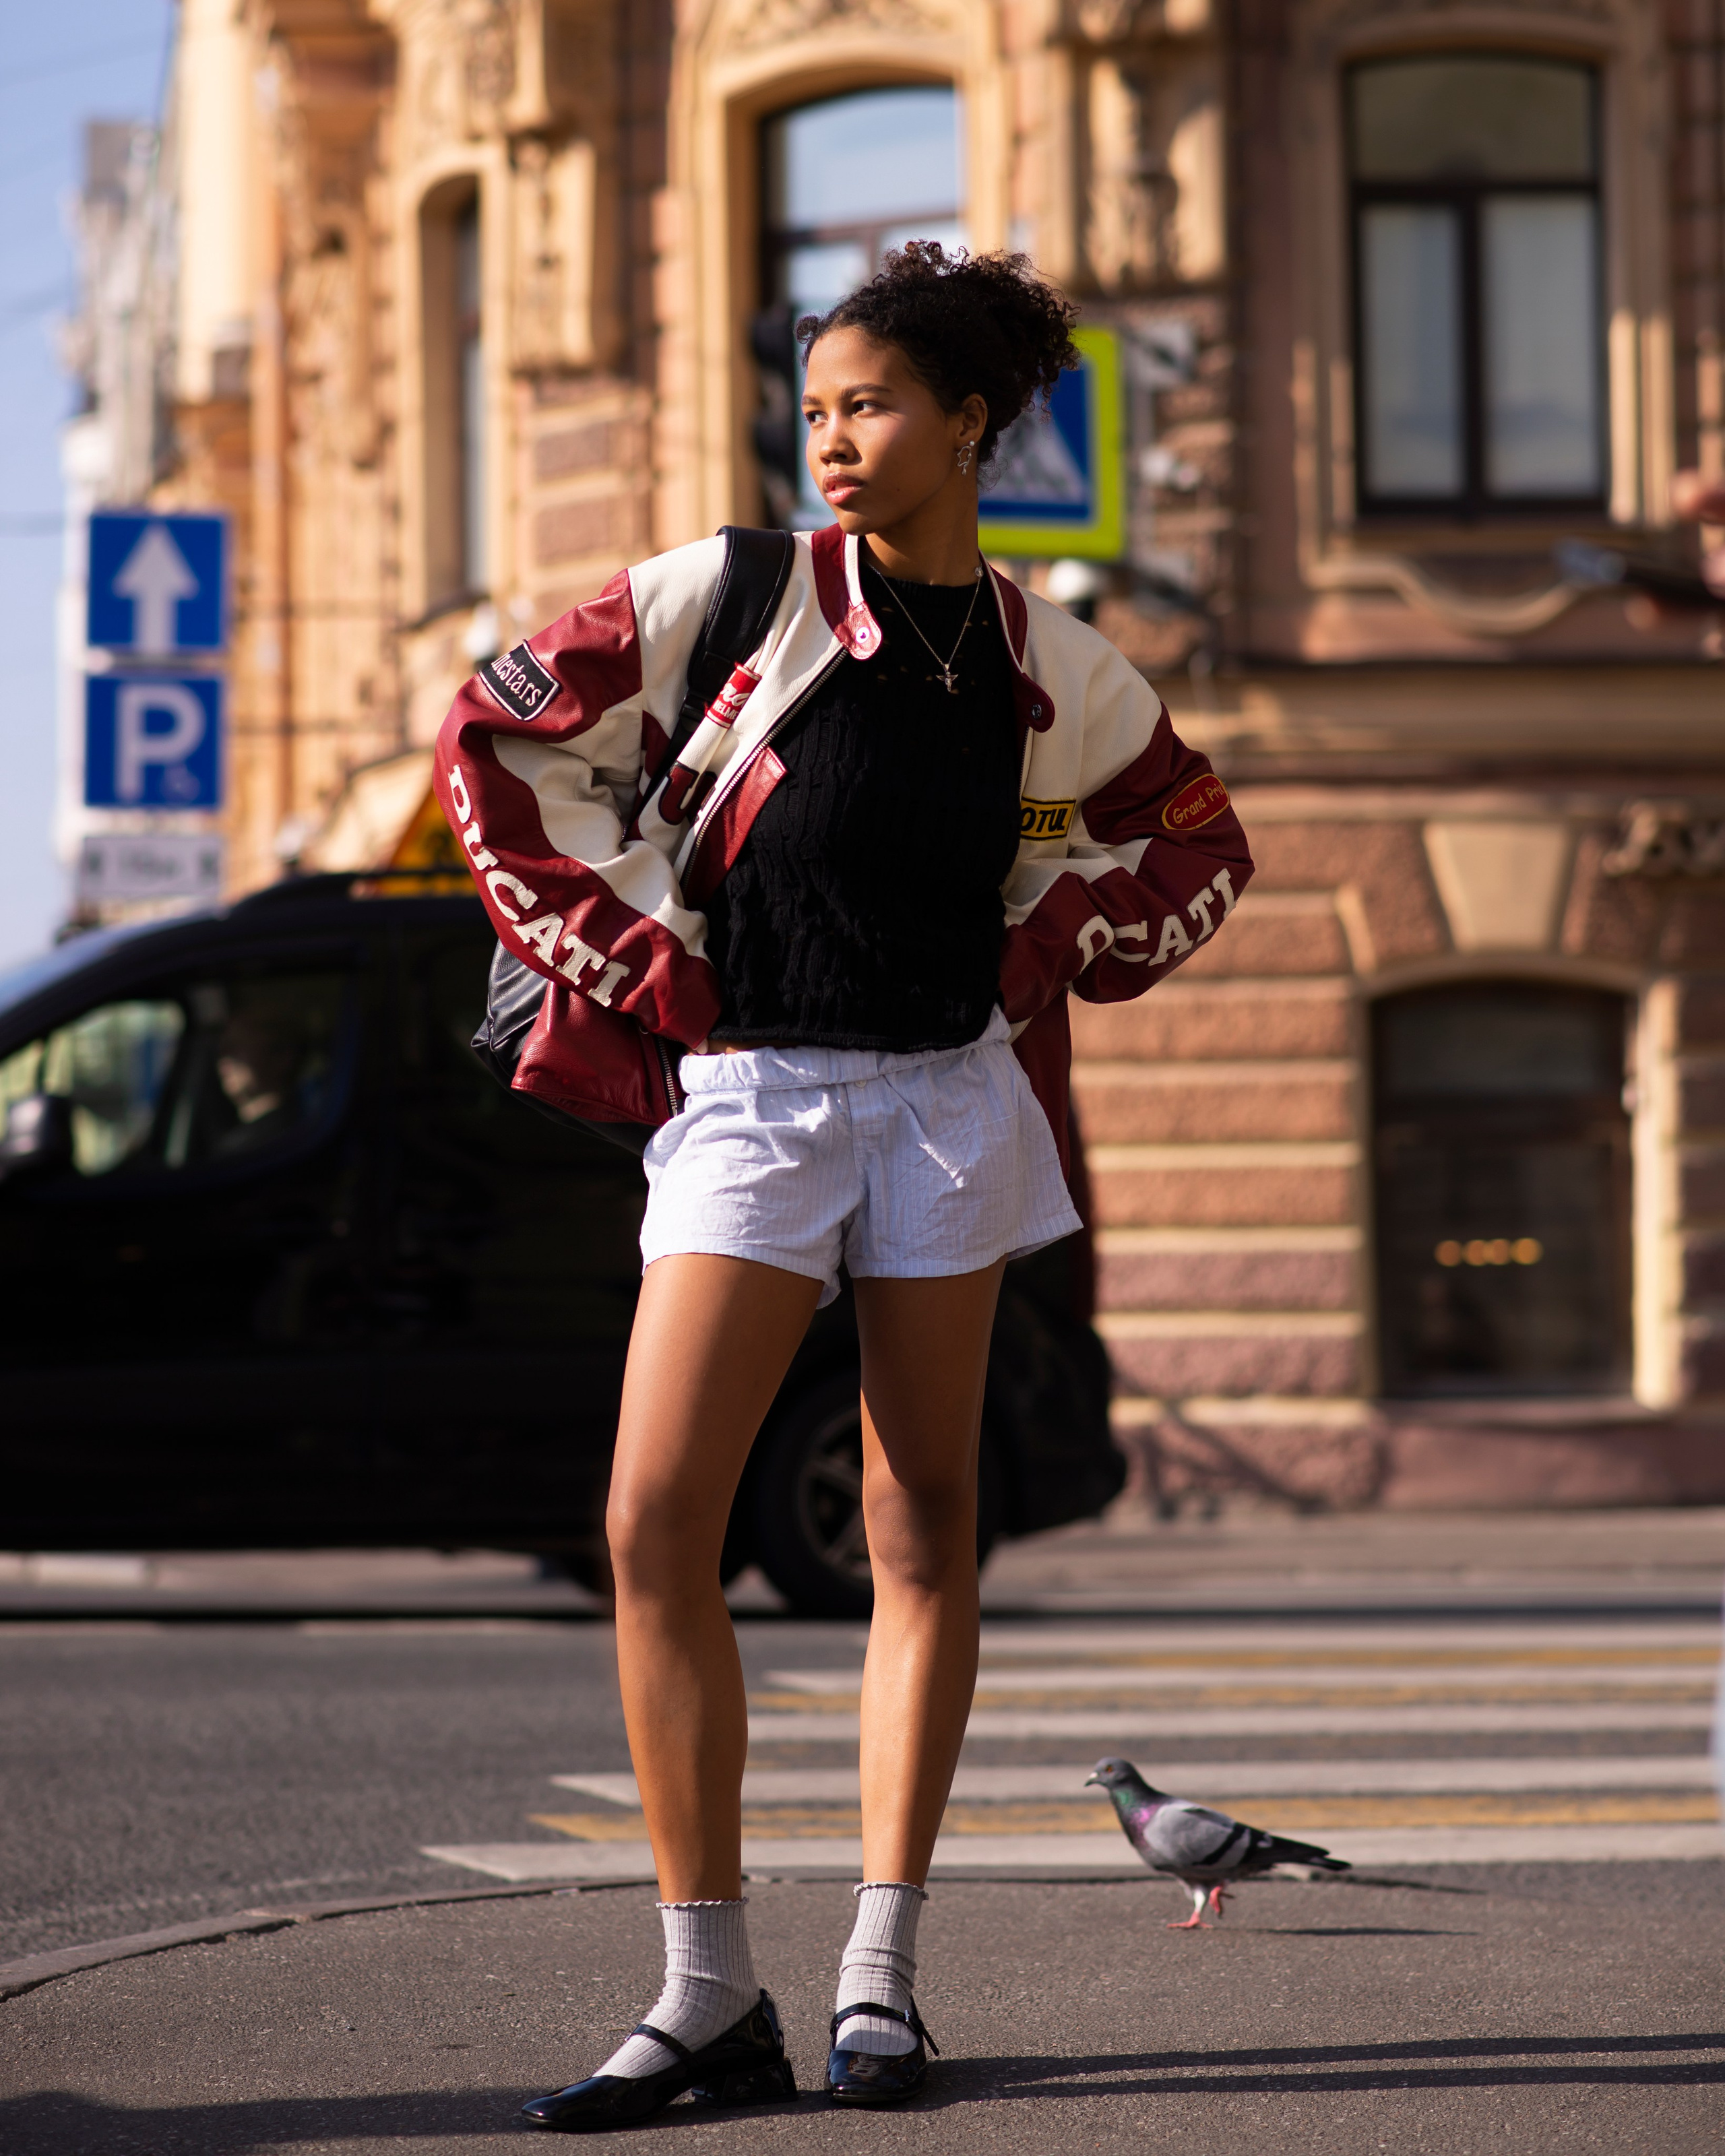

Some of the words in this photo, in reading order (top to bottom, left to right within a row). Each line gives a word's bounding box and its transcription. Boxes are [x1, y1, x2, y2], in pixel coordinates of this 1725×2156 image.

[115, 681, 206, 802] P
[1020, 806, 1069, 833] OTUL
[1172, 794, 1207, 824] Grand
[1205, 782, 1225, 802] Prix
[448, 764, 631, 1007] DUCATI
[1075, 867, 1237, 975] DCATI
